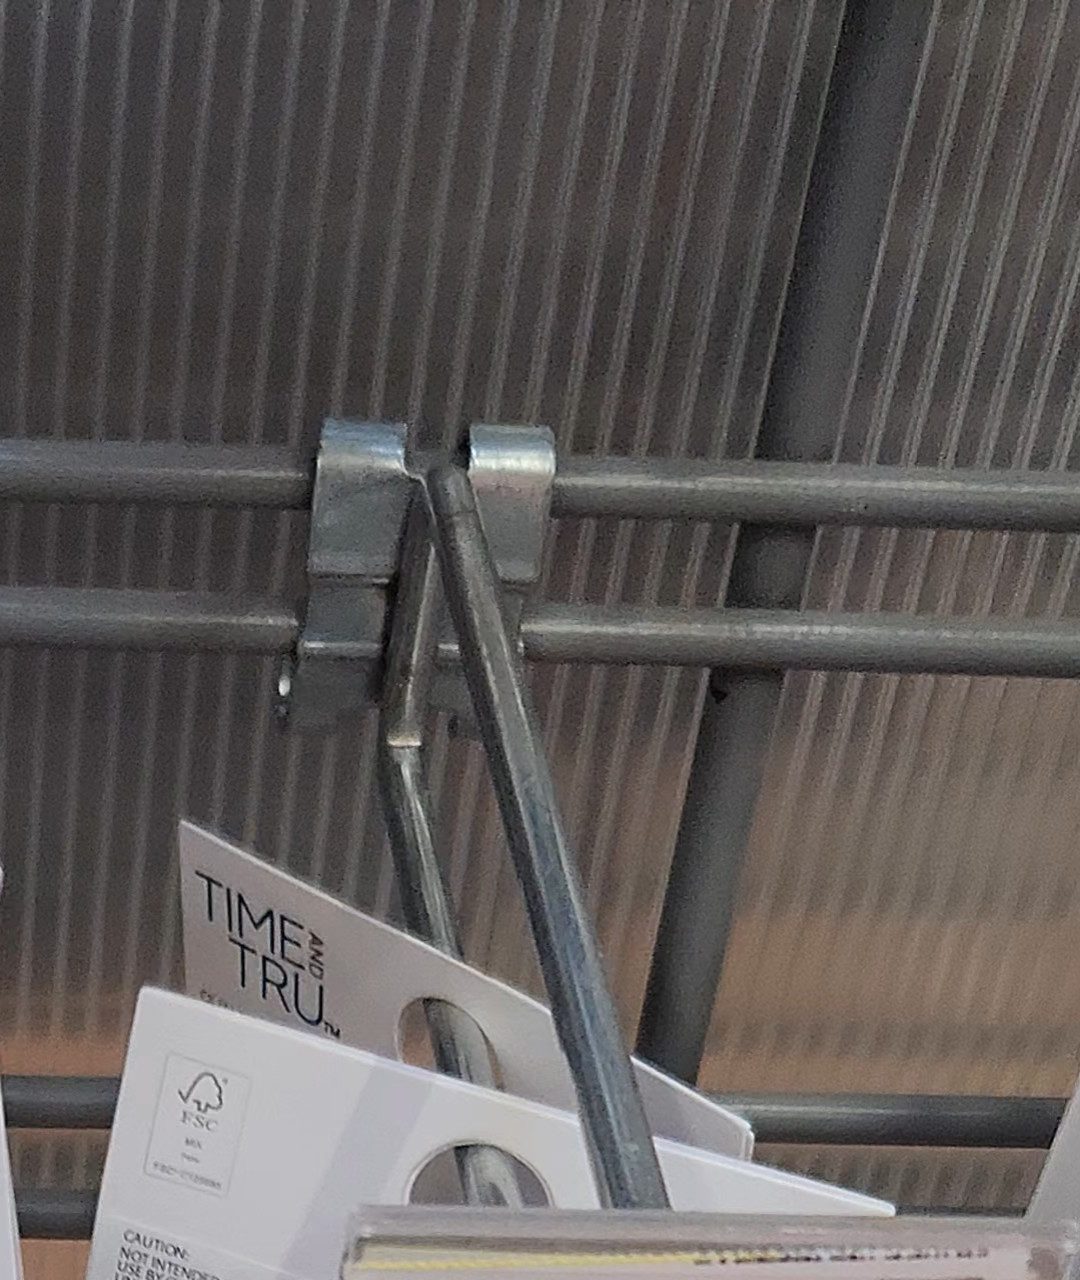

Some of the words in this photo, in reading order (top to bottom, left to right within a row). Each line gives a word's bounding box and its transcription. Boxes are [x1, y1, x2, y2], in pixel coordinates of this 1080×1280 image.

[195, 870, 305, 970] TIME
[181, 1110, 217, 1131] FSC
[121, 1228, 191, 1261] CAUTION:
[119, 1246, 148, 1265] NOT
[115, 1259, 142, 1277] USE
